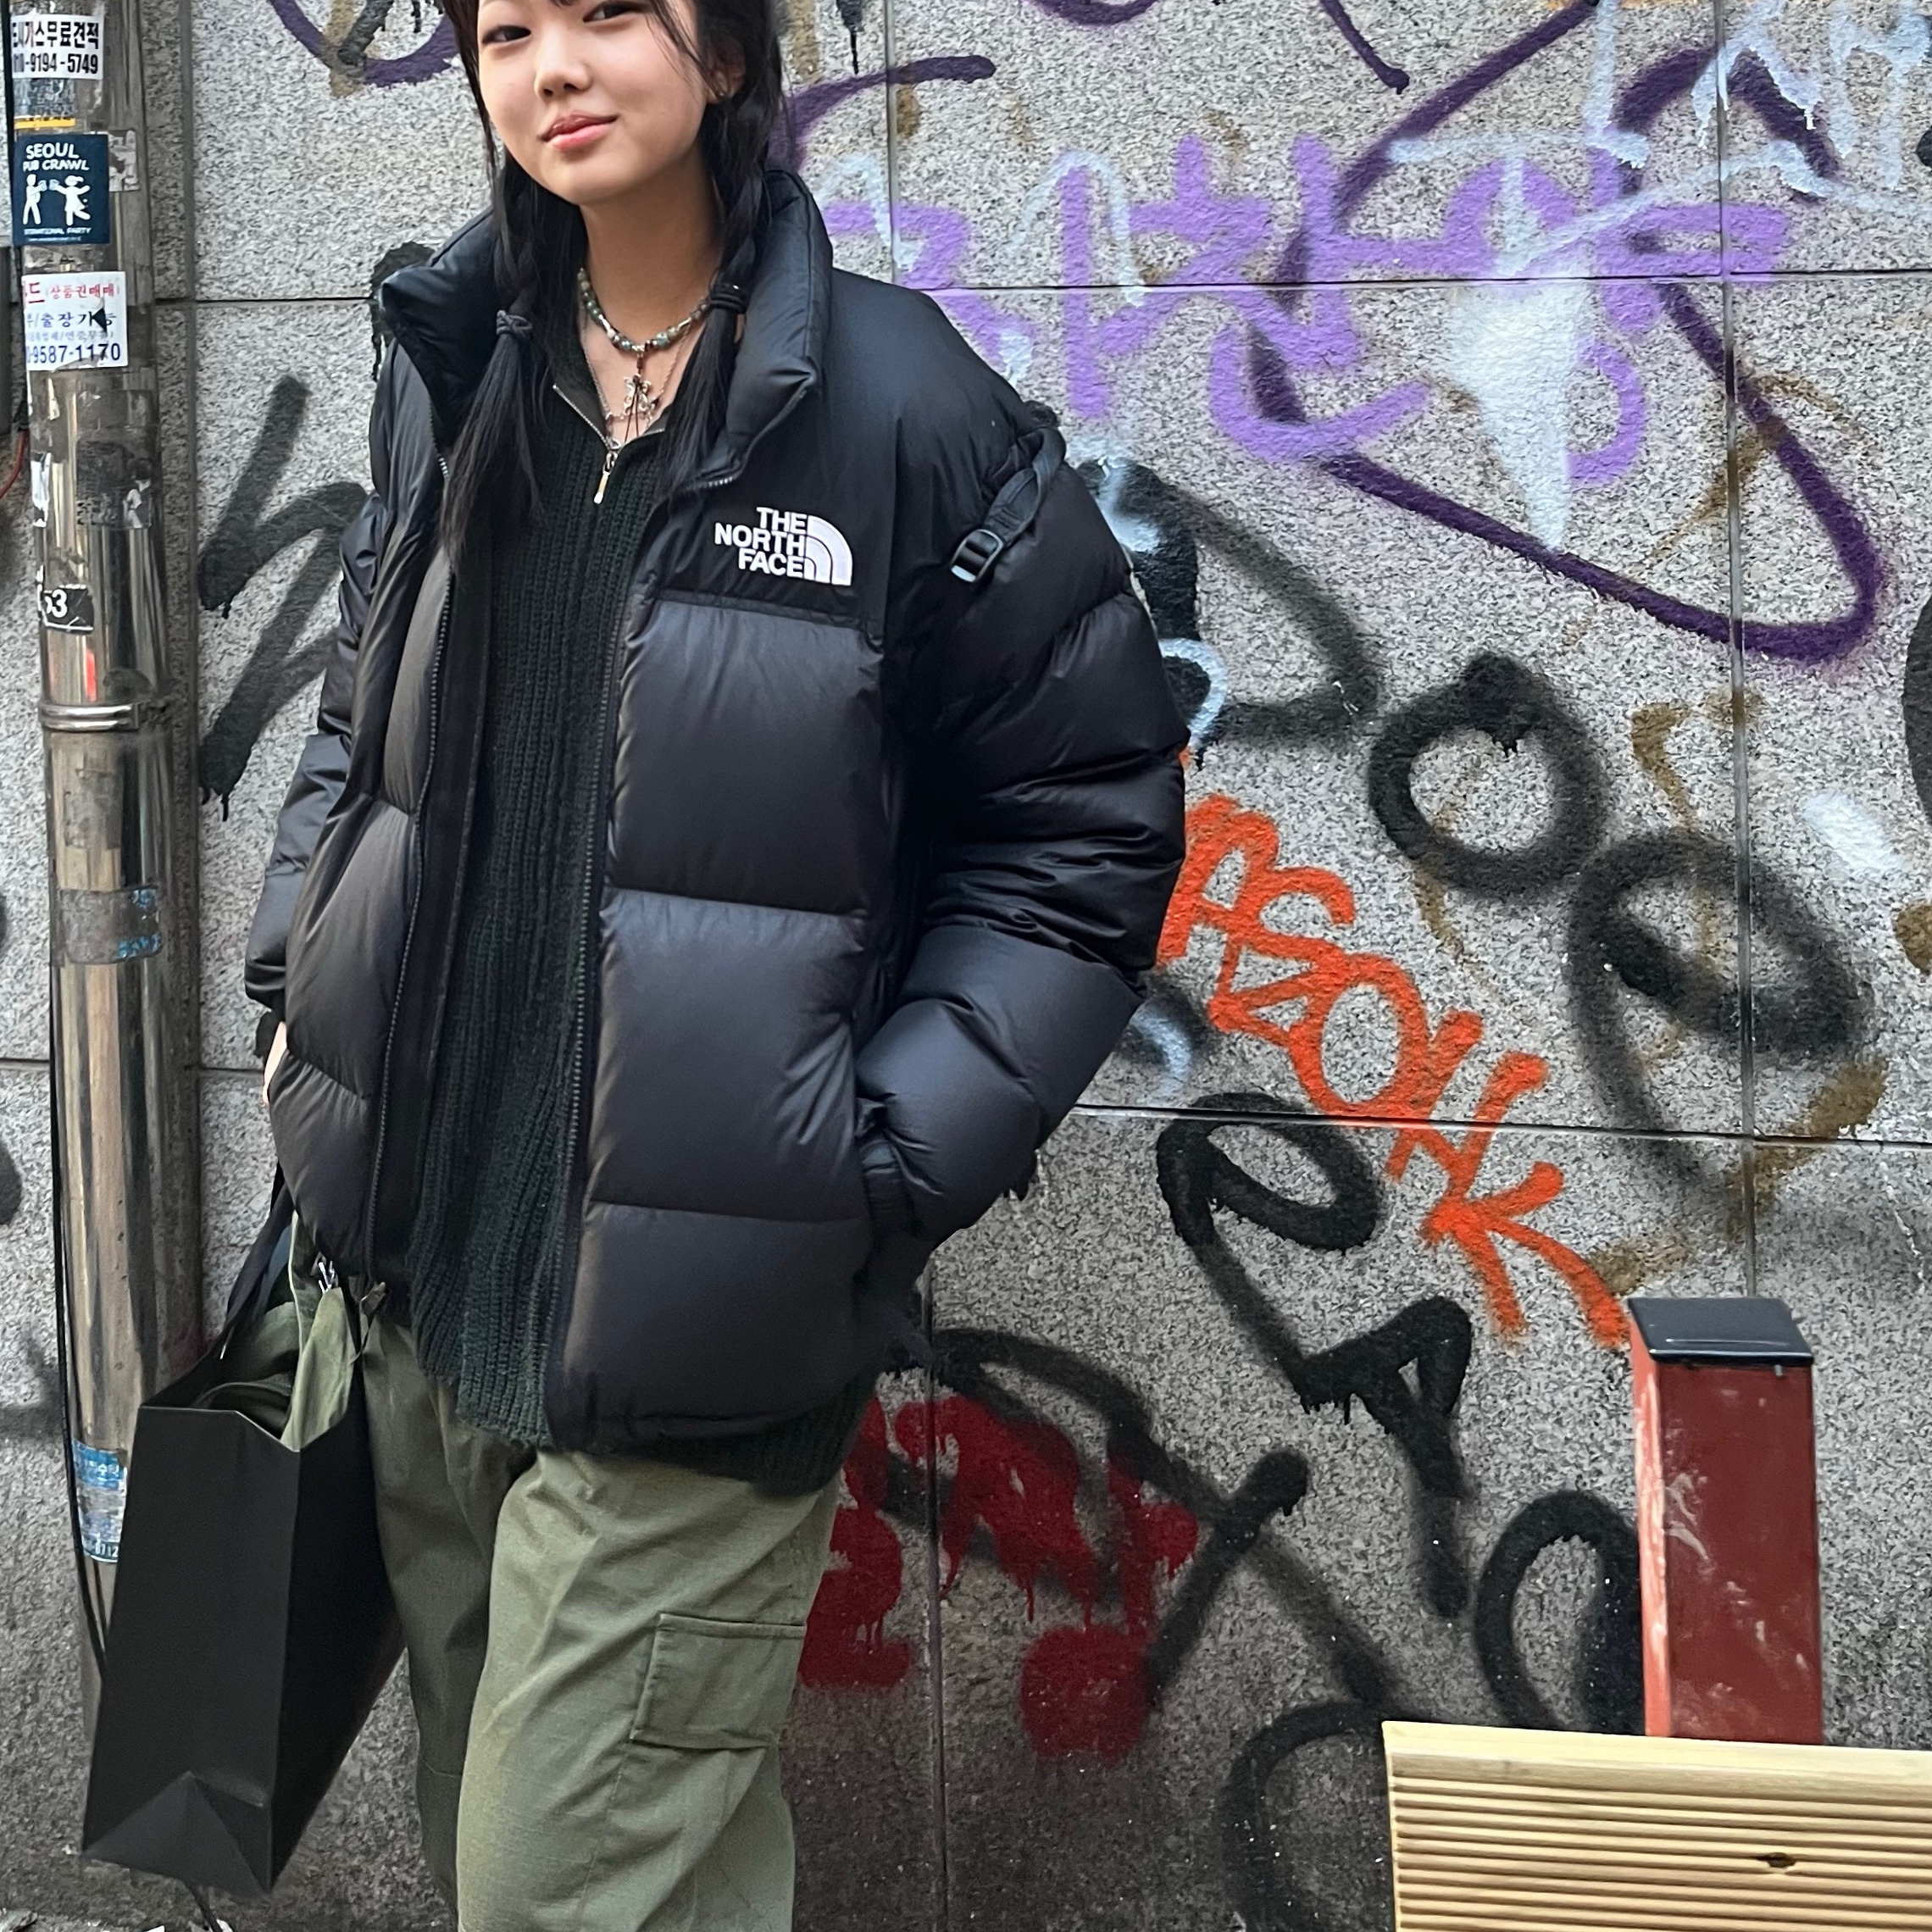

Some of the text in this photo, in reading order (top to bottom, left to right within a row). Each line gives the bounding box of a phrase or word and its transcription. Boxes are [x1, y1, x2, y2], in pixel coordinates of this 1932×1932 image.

[25, 142, 80, 160] SEOUL
[42, 158, 90, 171] CRAWL
[756, 507, 808, 535] THE
[714, 522, 806, 557] NORTH
[738, 547, 804, 579] FACE
